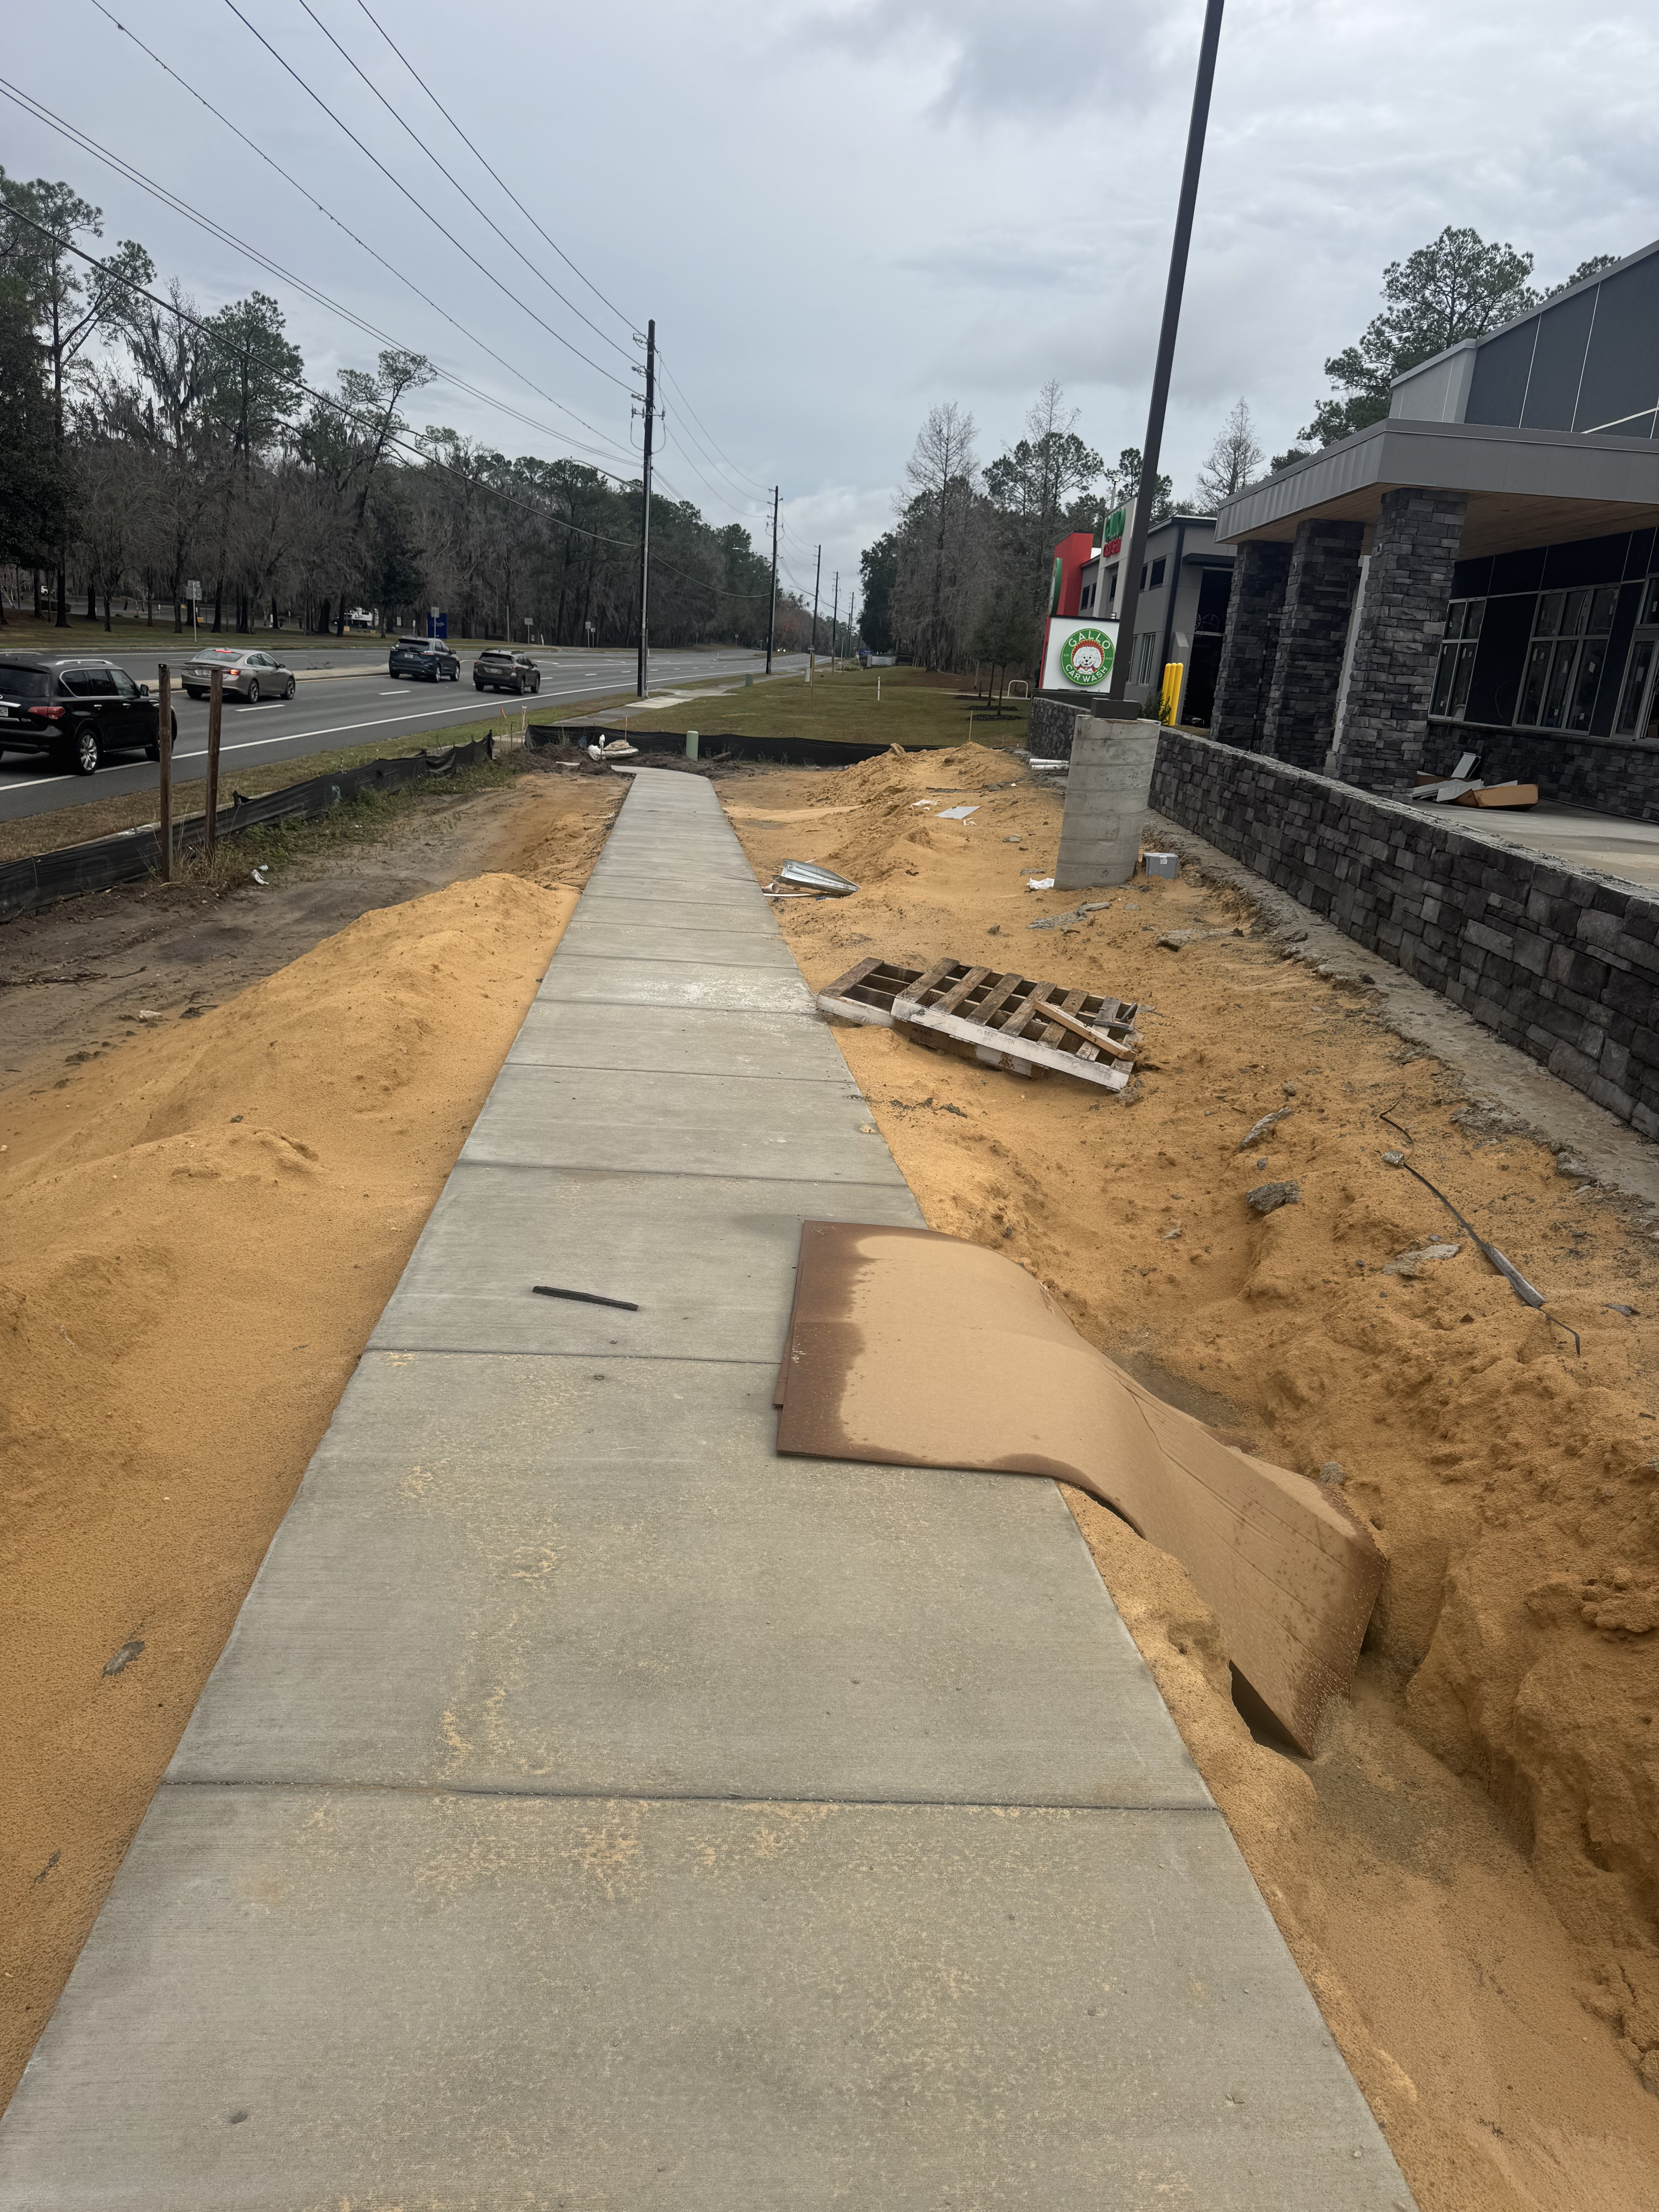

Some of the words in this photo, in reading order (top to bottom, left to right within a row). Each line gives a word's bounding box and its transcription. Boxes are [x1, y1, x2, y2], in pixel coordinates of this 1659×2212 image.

[1068, 631, 1111, 649] GALLO
[1066, 664, 1080, 680] CAR
[1082, 666, 1108, 682] WASH
